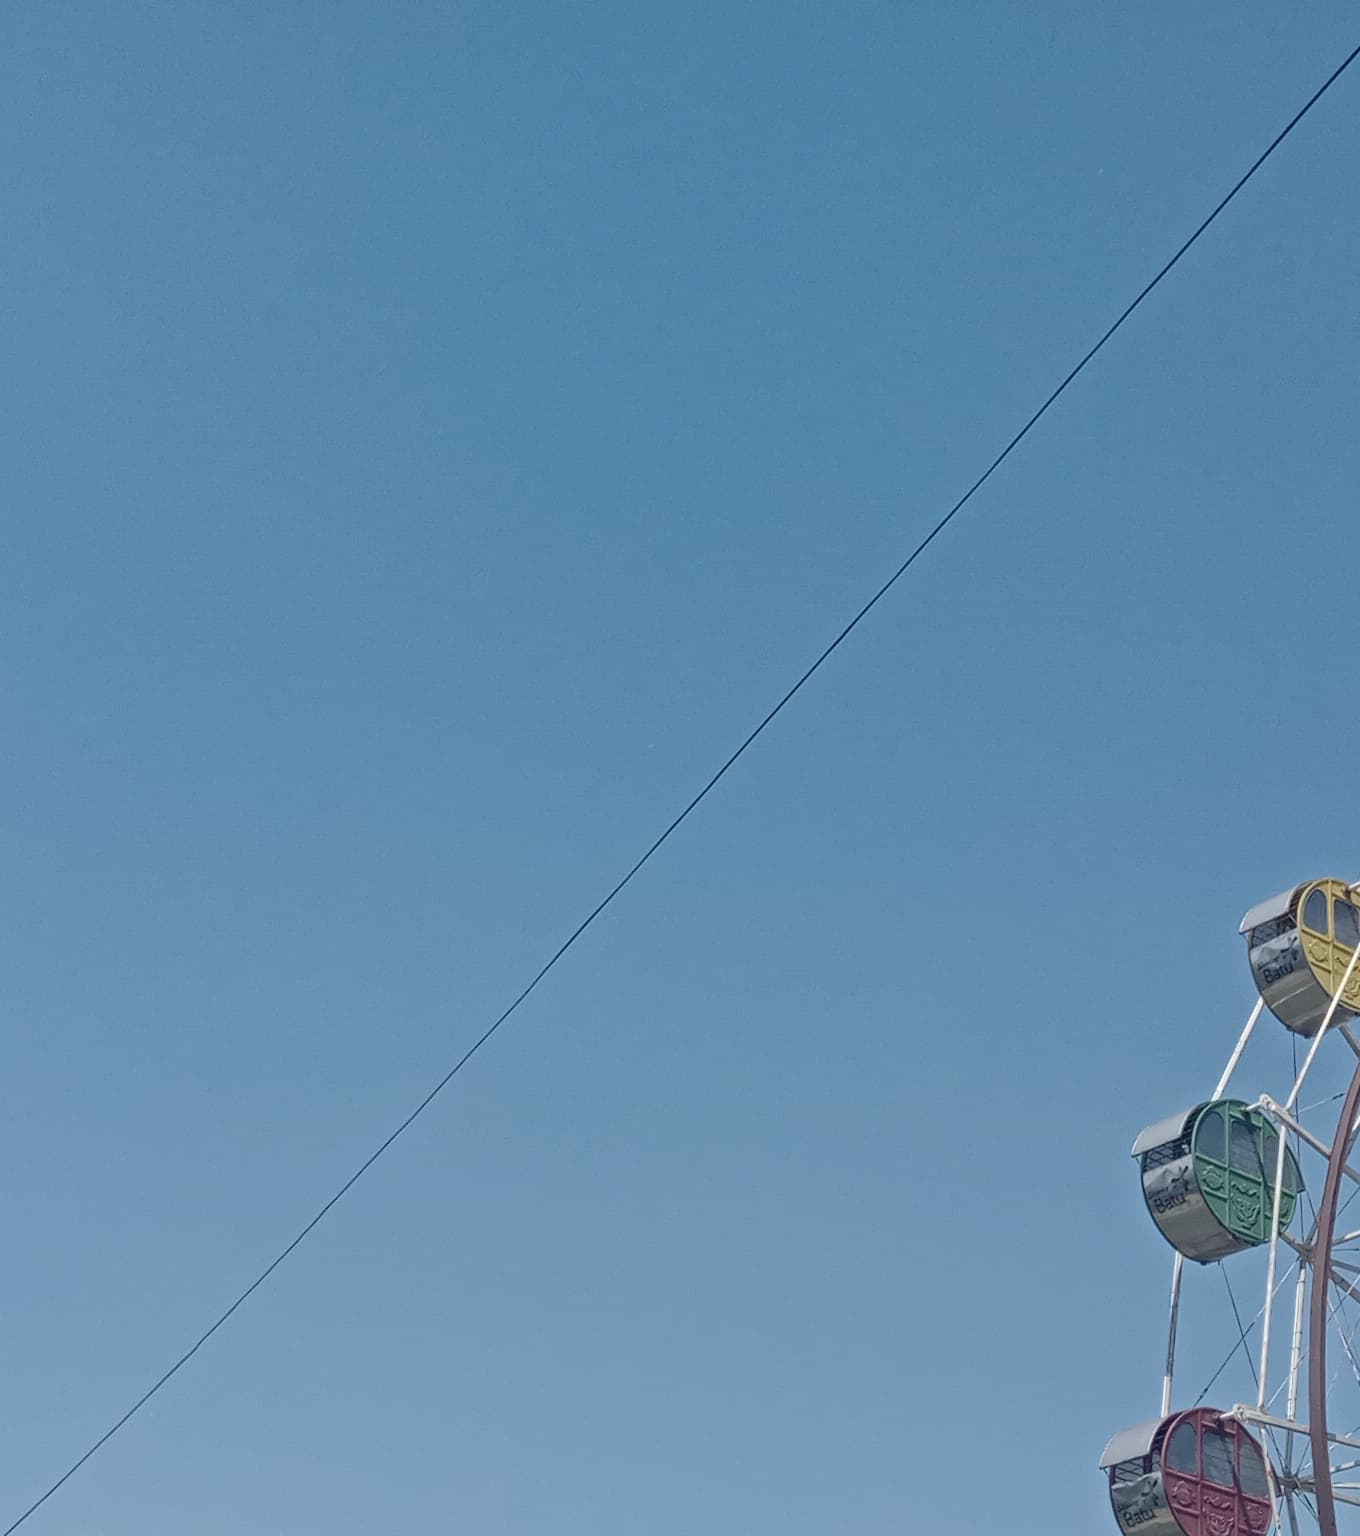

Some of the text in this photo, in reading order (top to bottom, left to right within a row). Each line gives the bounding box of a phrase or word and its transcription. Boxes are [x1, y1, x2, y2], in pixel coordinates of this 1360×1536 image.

[1263, 963, 1293, 983] Batu
[1154, 1194, 1186, 1213] Batu
[1123, 1509, 1156, 1527] Batu
